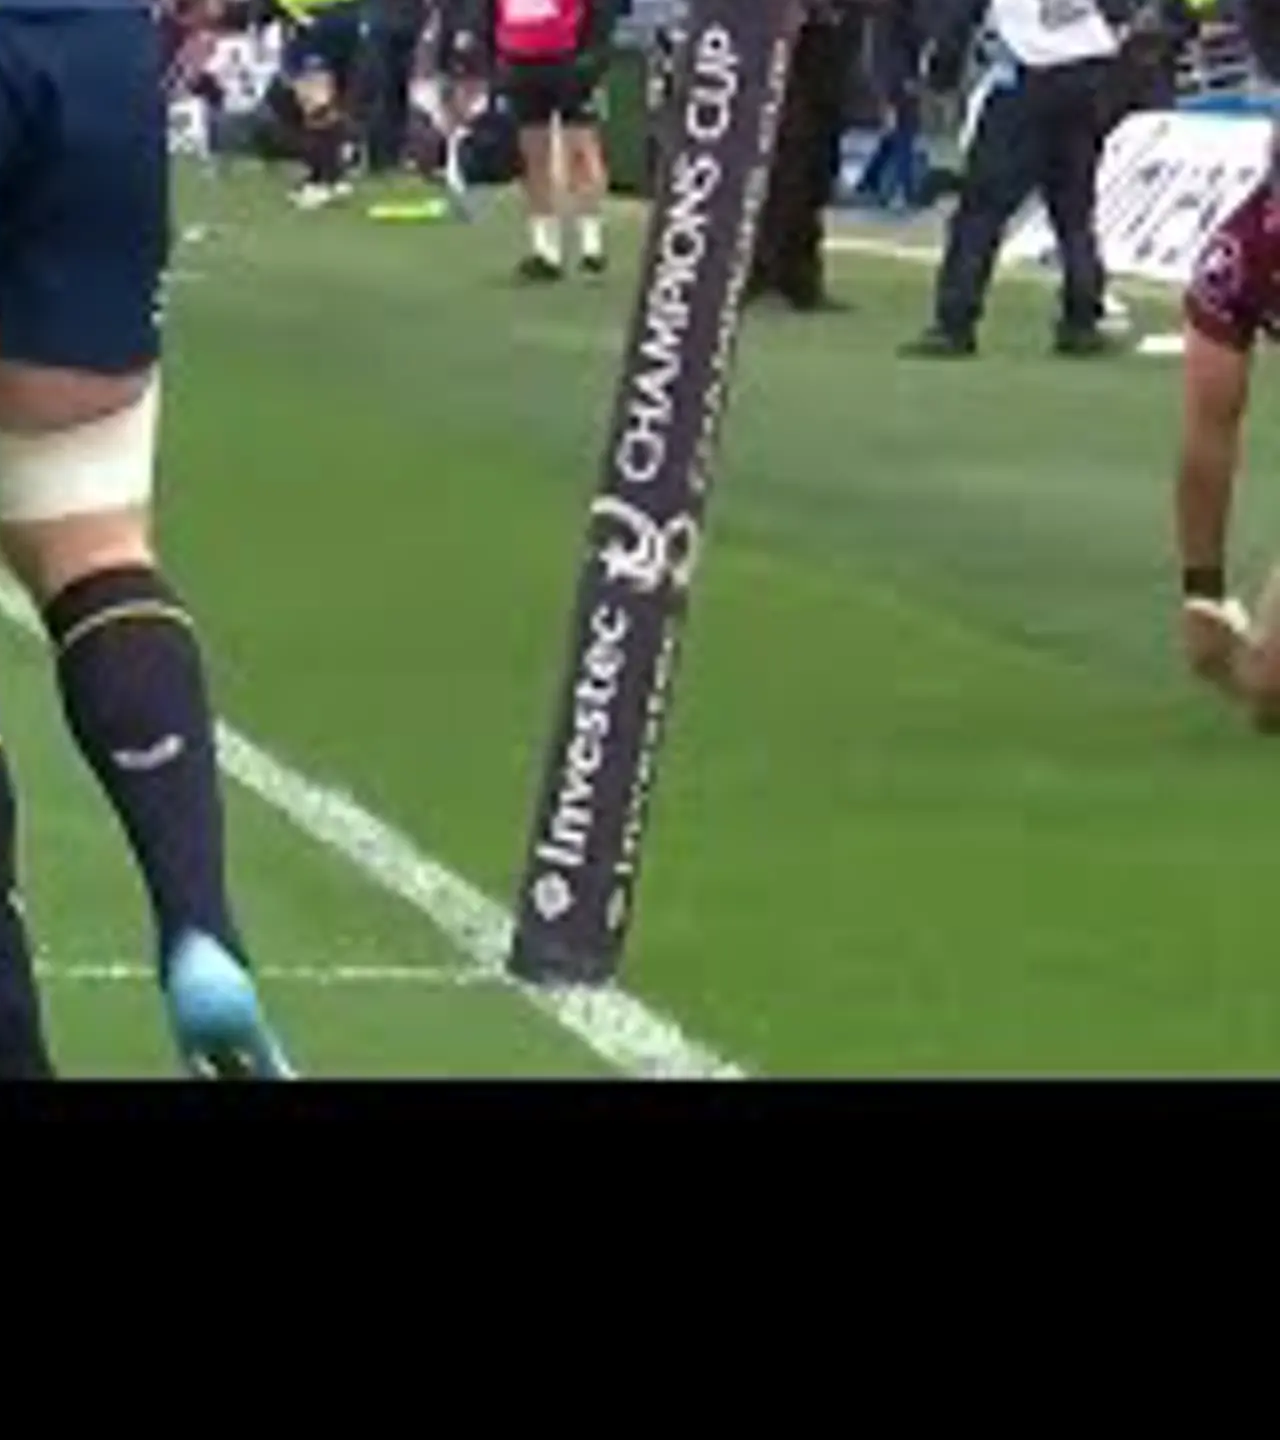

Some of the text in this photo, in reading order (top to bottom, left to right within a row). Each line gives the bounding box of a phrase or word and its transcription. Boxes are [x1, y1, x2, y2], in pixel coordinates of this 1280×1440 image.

[536, 605, 630, 866] Investec
[616, 153, 721, 483] CHAMPIONS
[686, 21, 740, 143] CUP
